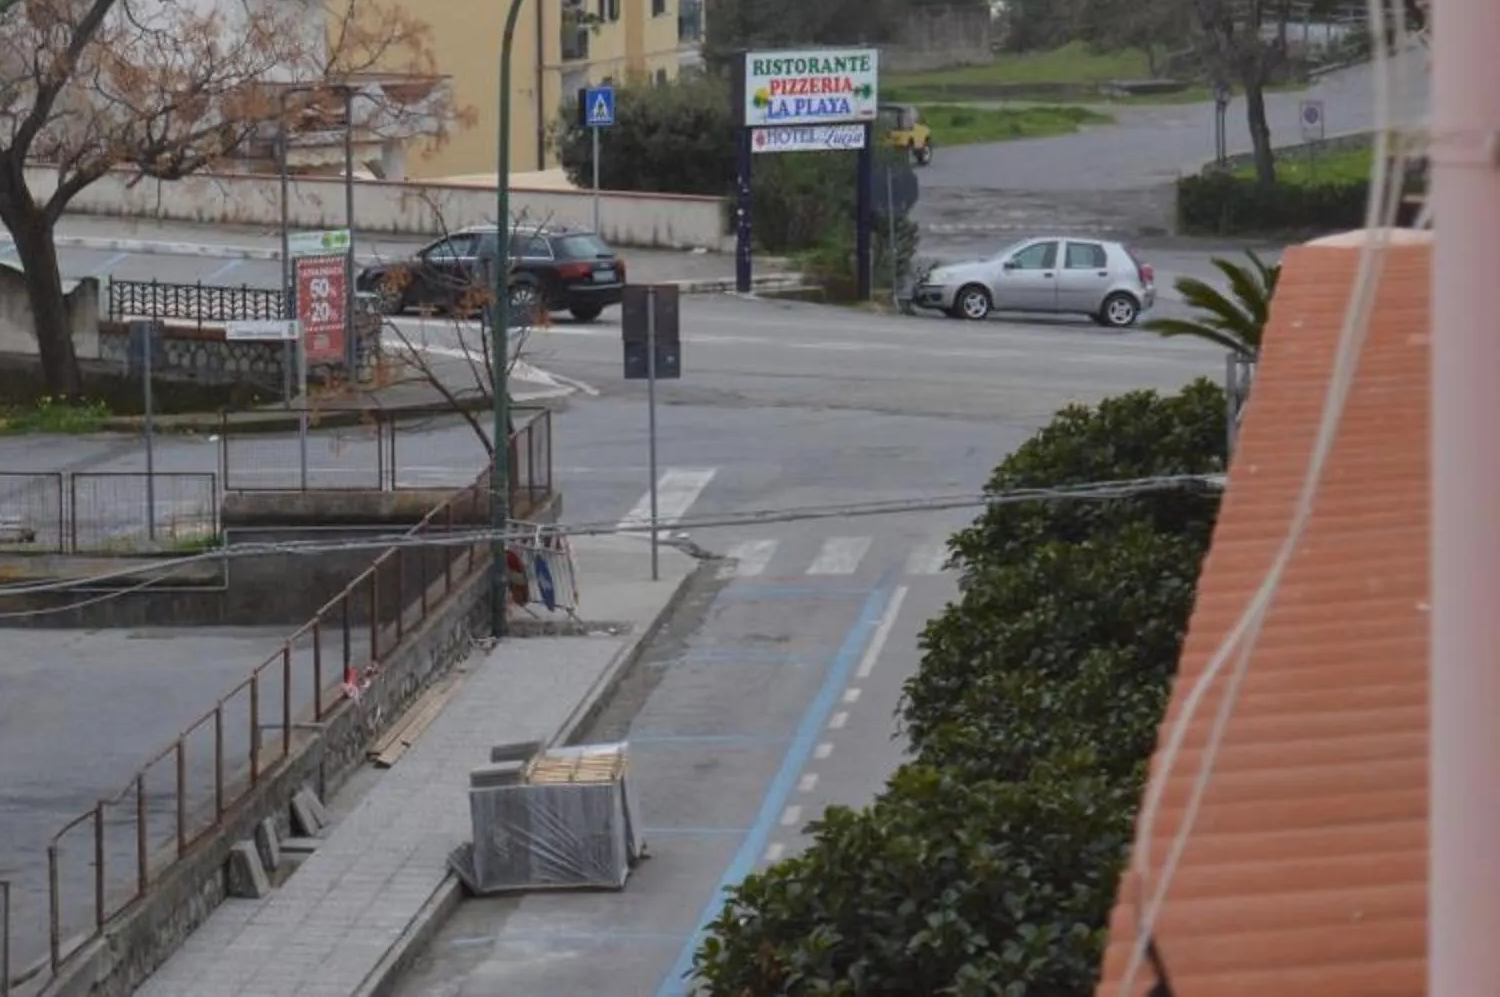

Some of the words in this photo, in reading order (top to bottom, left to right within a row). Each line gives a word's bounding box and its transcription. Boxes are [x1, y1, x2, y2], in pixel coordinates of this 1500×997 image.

[753, 55, 871, 76] RISTORANTE
[770, 76, 853, 96] PIZZERIA
[767, 99, 790, 118] LA
[794, 97, 851, 117] PLAYA
[767, 128, 816, 147] HOTEL
